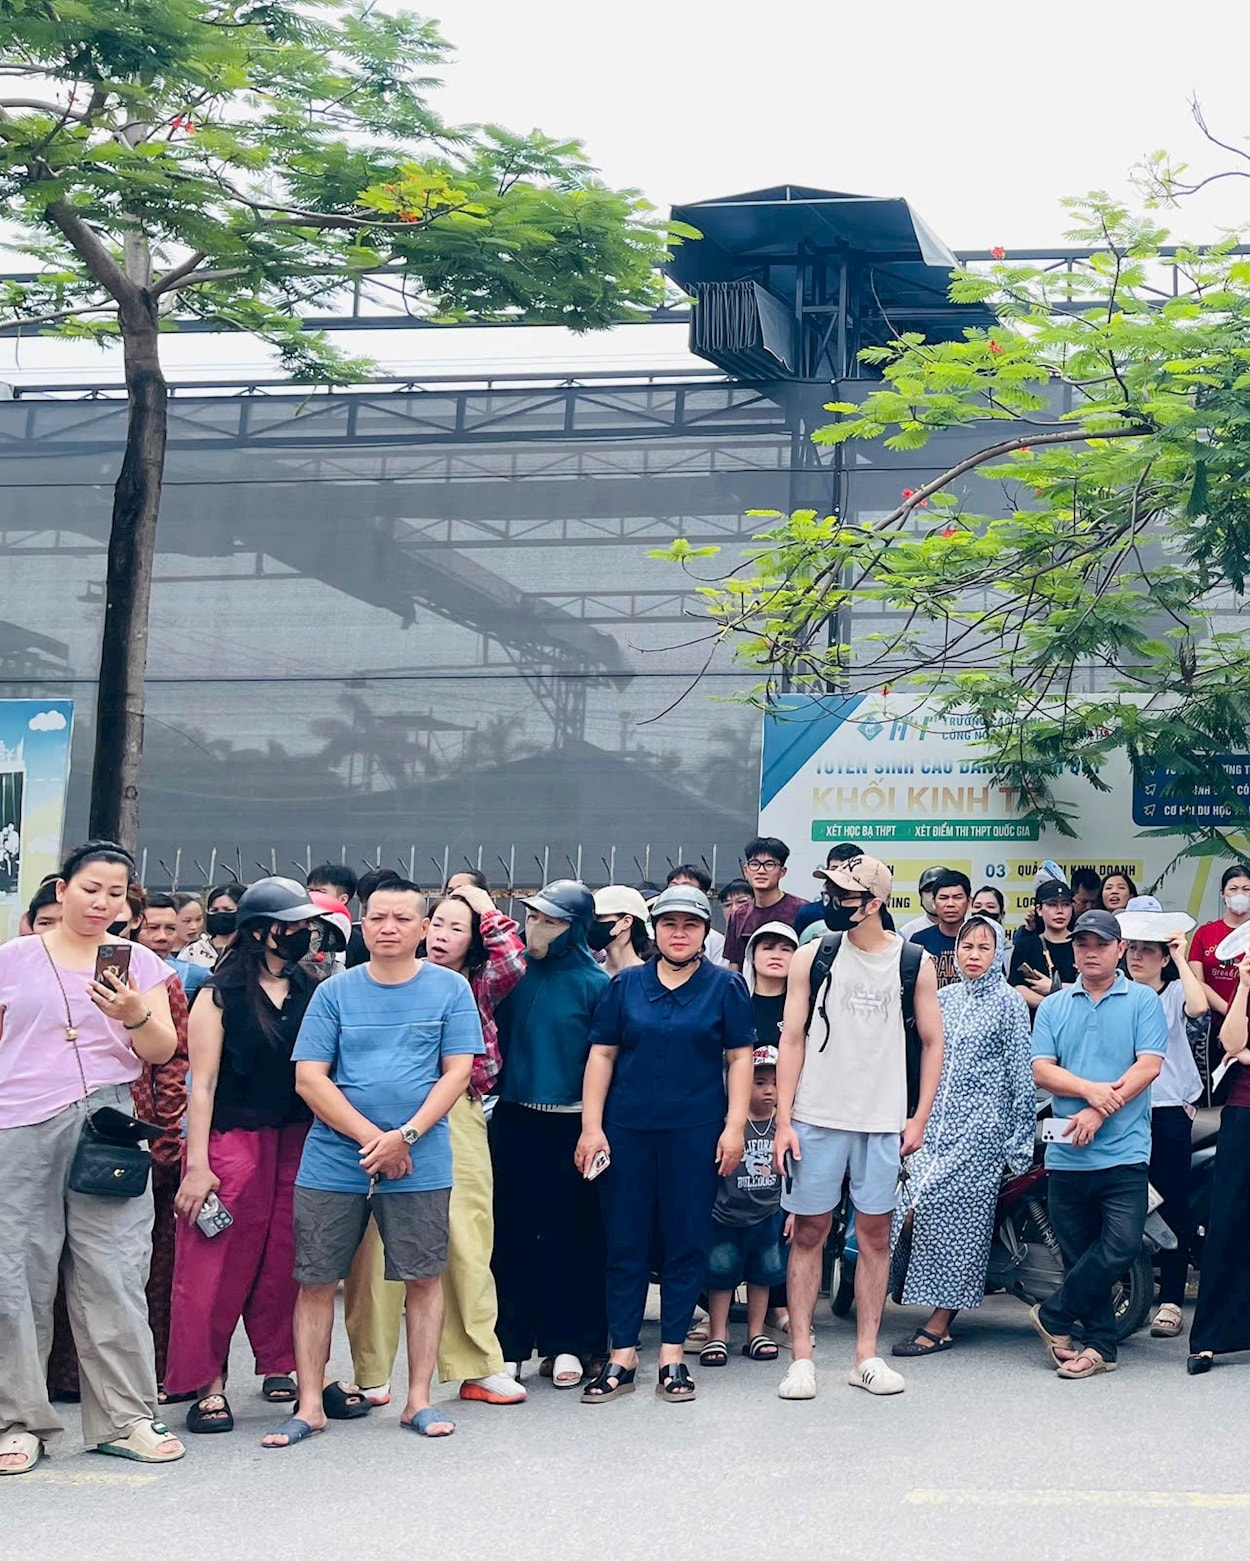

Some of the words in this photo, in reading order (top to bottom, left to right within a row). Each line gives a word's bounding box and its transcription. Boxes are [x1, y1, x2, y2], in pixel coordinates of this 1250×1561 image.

[811, 778, 896, 814] KHỐI
[906, 786, 989, 814] KINH
[1236, 783, 1250, 796] CÓ
[1197, 805, 1210, 816] DU
[825, 824, 842, 837] XÉT
[843, 825, 861, 839] HỌC
[862, 825, 874, 839] BẠ
[876, 825, 897, 837] THPT
[914, 824, 932, 837] XÉT
[932, 822, 954, 837] ĐIỂM
[955, 825, 969, 837] THI
[970, 825, 992, 837] THPT
[993, 822, 1016, 838] QUỐC
[1016, 825, 1031, 837] GIA
[985, 863, 1006, 878] 03
[1017, 860, 1044, 878] QUẢ
